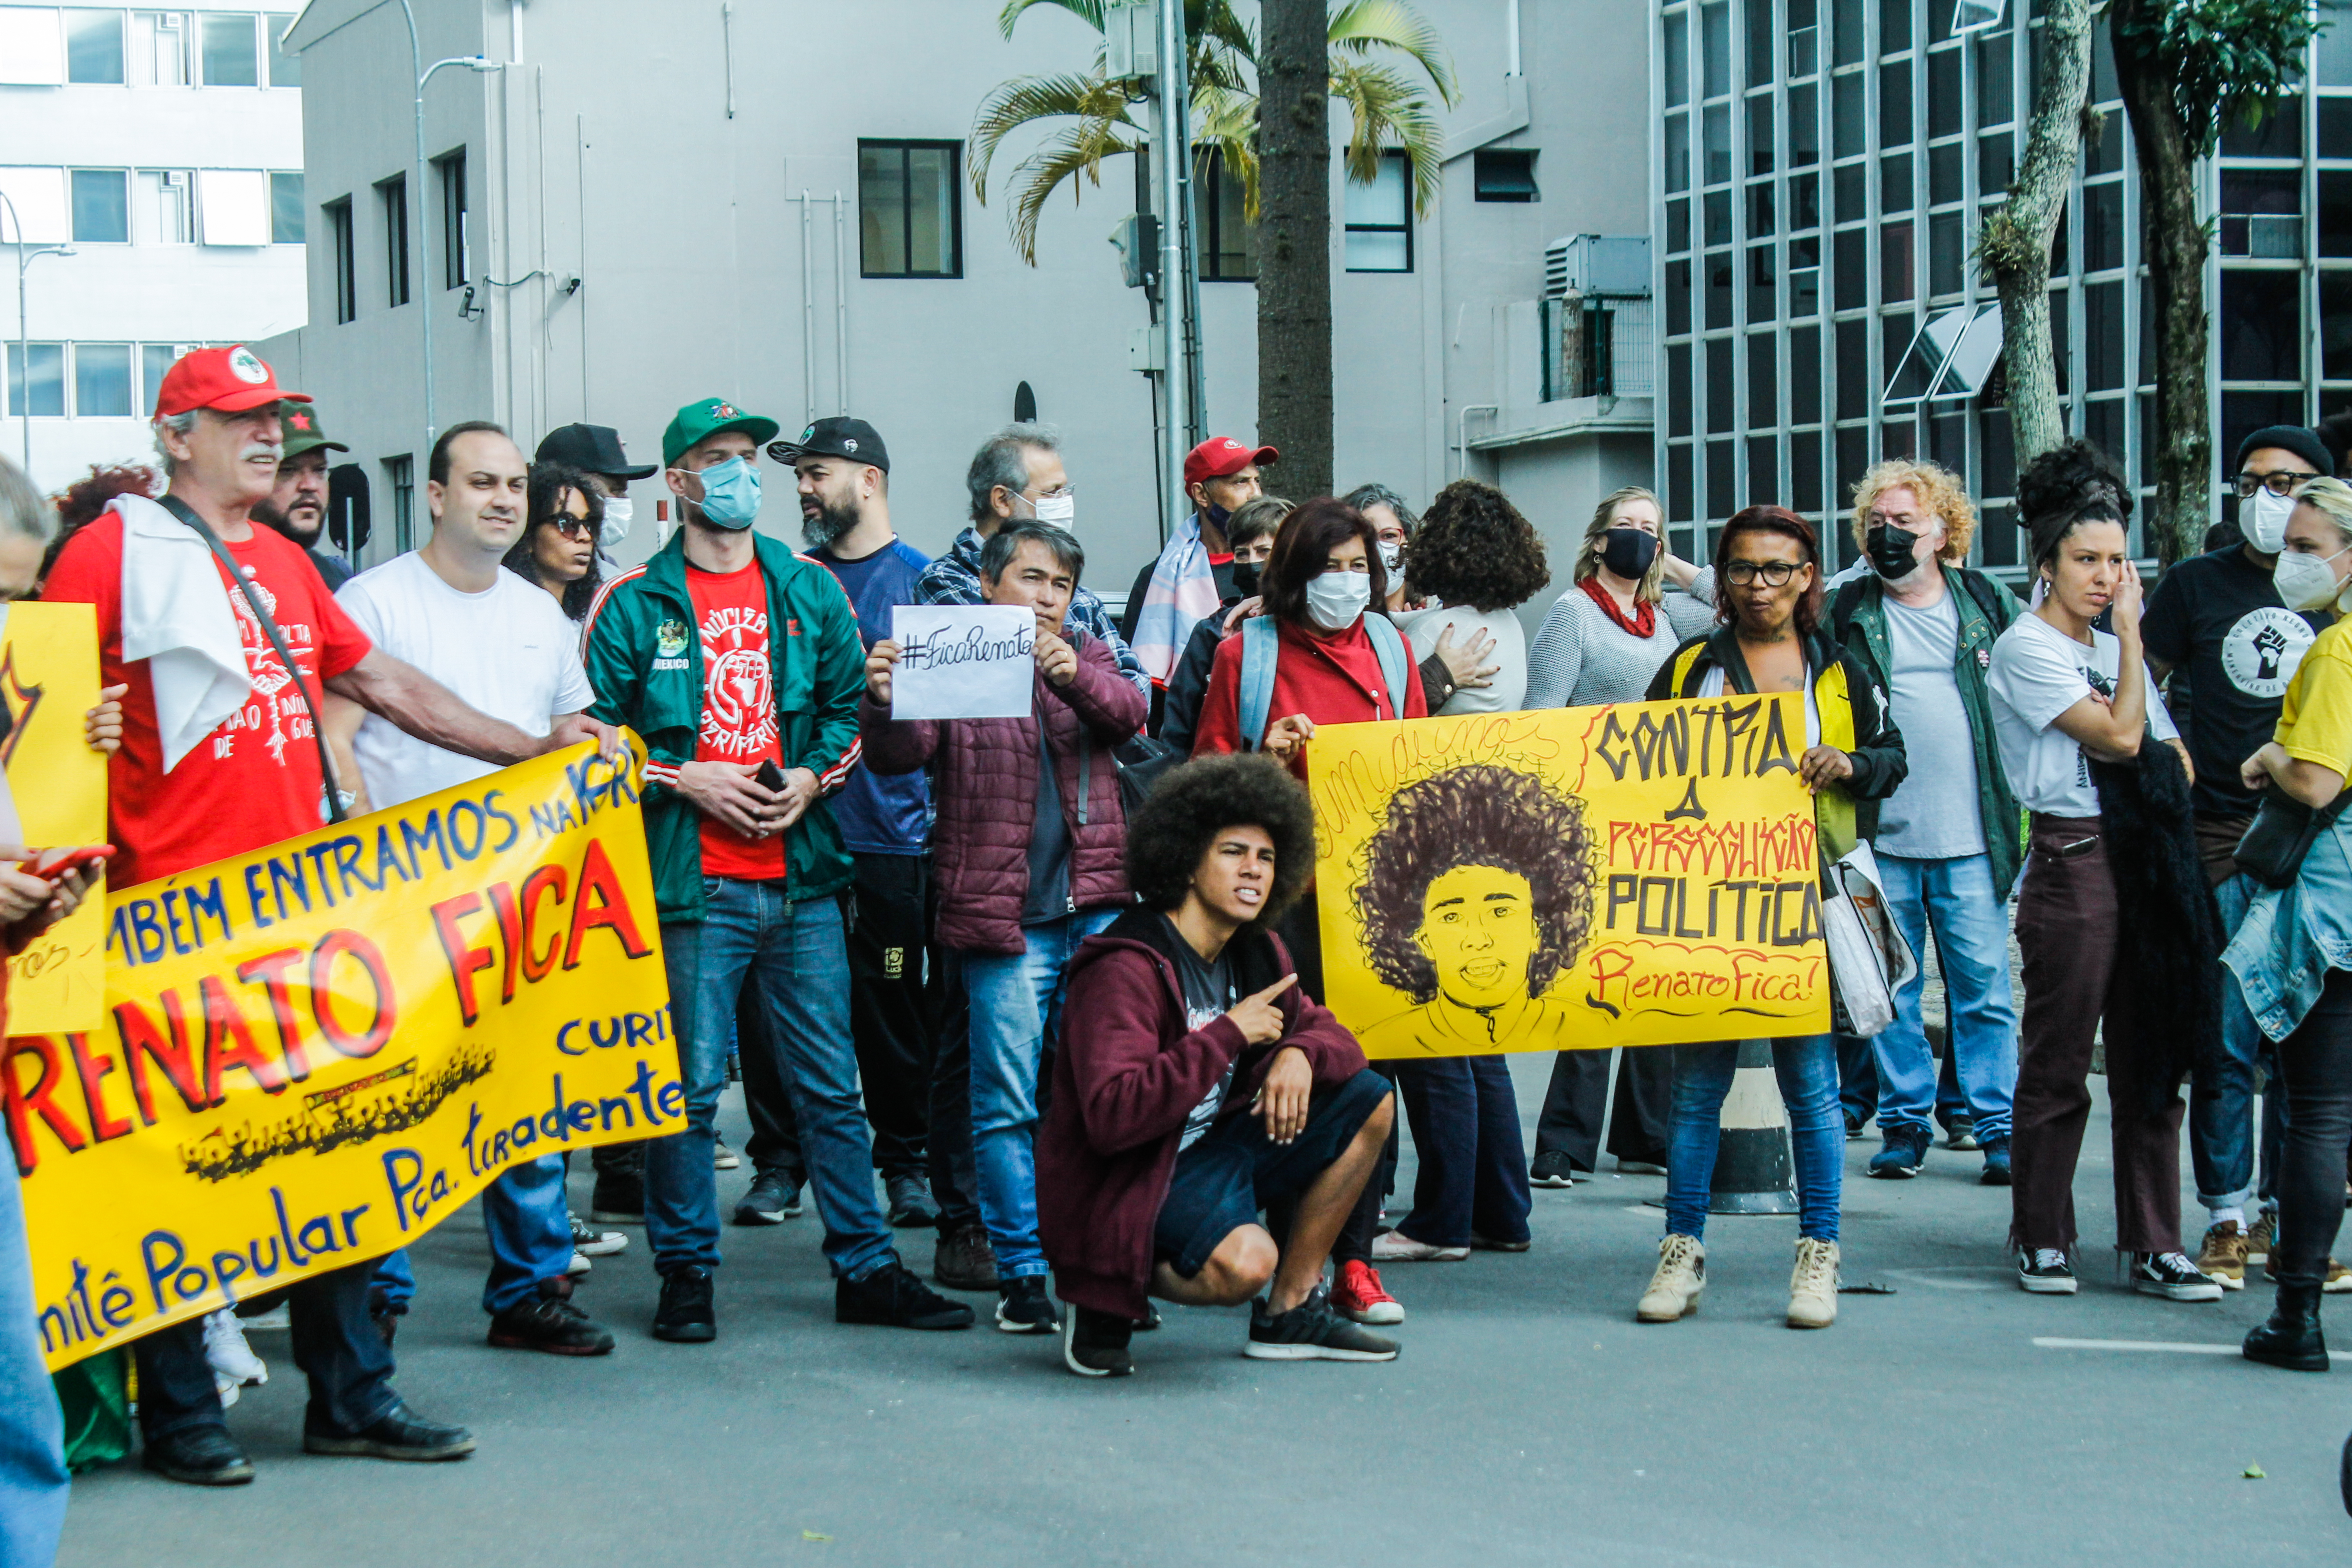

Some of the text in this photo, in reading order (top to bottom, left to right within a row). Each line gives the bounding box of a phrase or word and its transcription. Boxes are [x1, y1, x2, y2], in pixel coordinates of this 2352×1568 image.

[2232, 611, 2309, 639] COLETIVO NEGRO
[652, 658, 690, 670] MEXICO
[213, 734, 235, 760] DE
[1596, 698, 1799, 781] CONTRA
[1664, 775, 1708, 822] A
[244, 789, 519, 928] ENTRAMOS
[529, 799, 578, 839] NA
[2, 838, 654, 1178] RENATO FICA
[142, 1185, 371, 1315] Popular
